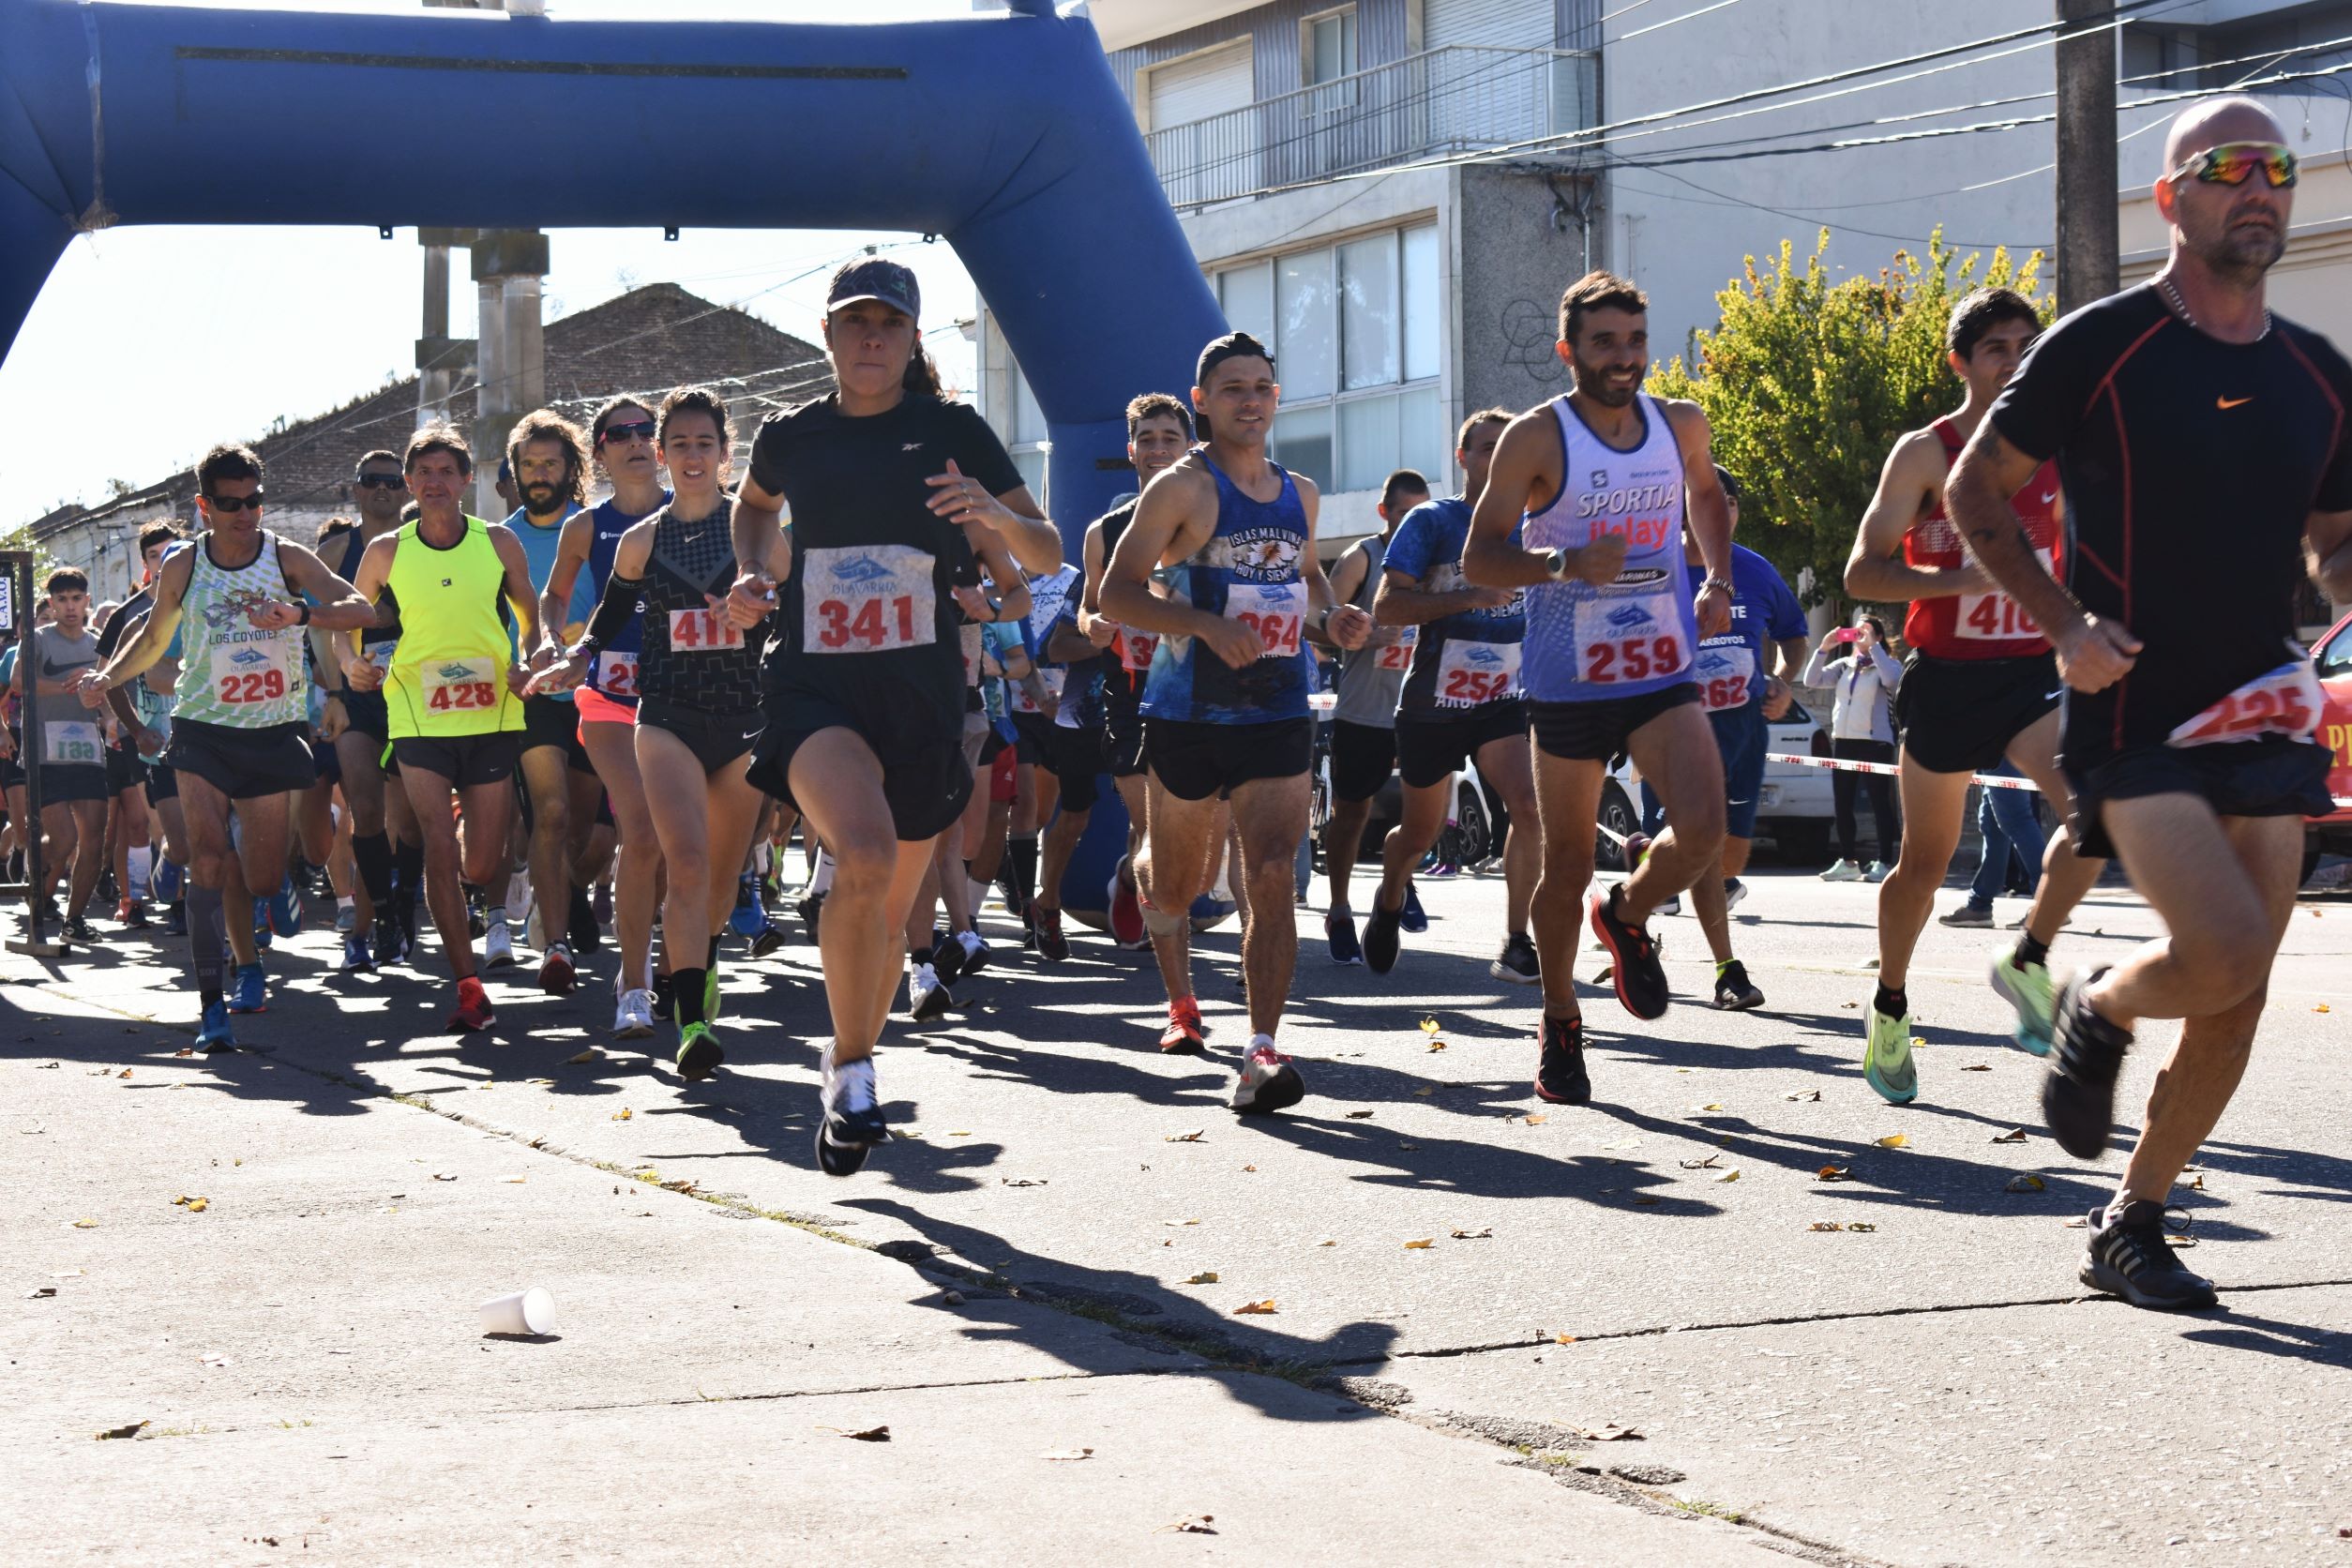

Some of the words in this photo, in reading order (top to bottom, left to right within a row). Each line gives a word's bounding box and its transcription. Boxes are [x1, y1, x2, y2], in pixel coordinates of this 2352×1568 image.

[1576, 482, 1678, 518] SPORTIA
[1229, 527, 1257, 546] ISLAS
[1236, 564, 1256, 580] HOY
[1257, 569, 1263, 580] Y
[832, 582, 897, 595] OLAVARRIA
[819, 595, 913, 648] 341
[209, 633, 230, 645] LOS
[1698, 635, 1746, 647] ARROYOS
[1586, 635, 1681, 683] 259
[220, 669, 284, 703] 229
[430, 682, 496, 711] 428
[1445, 670, 1508, 701] 252
